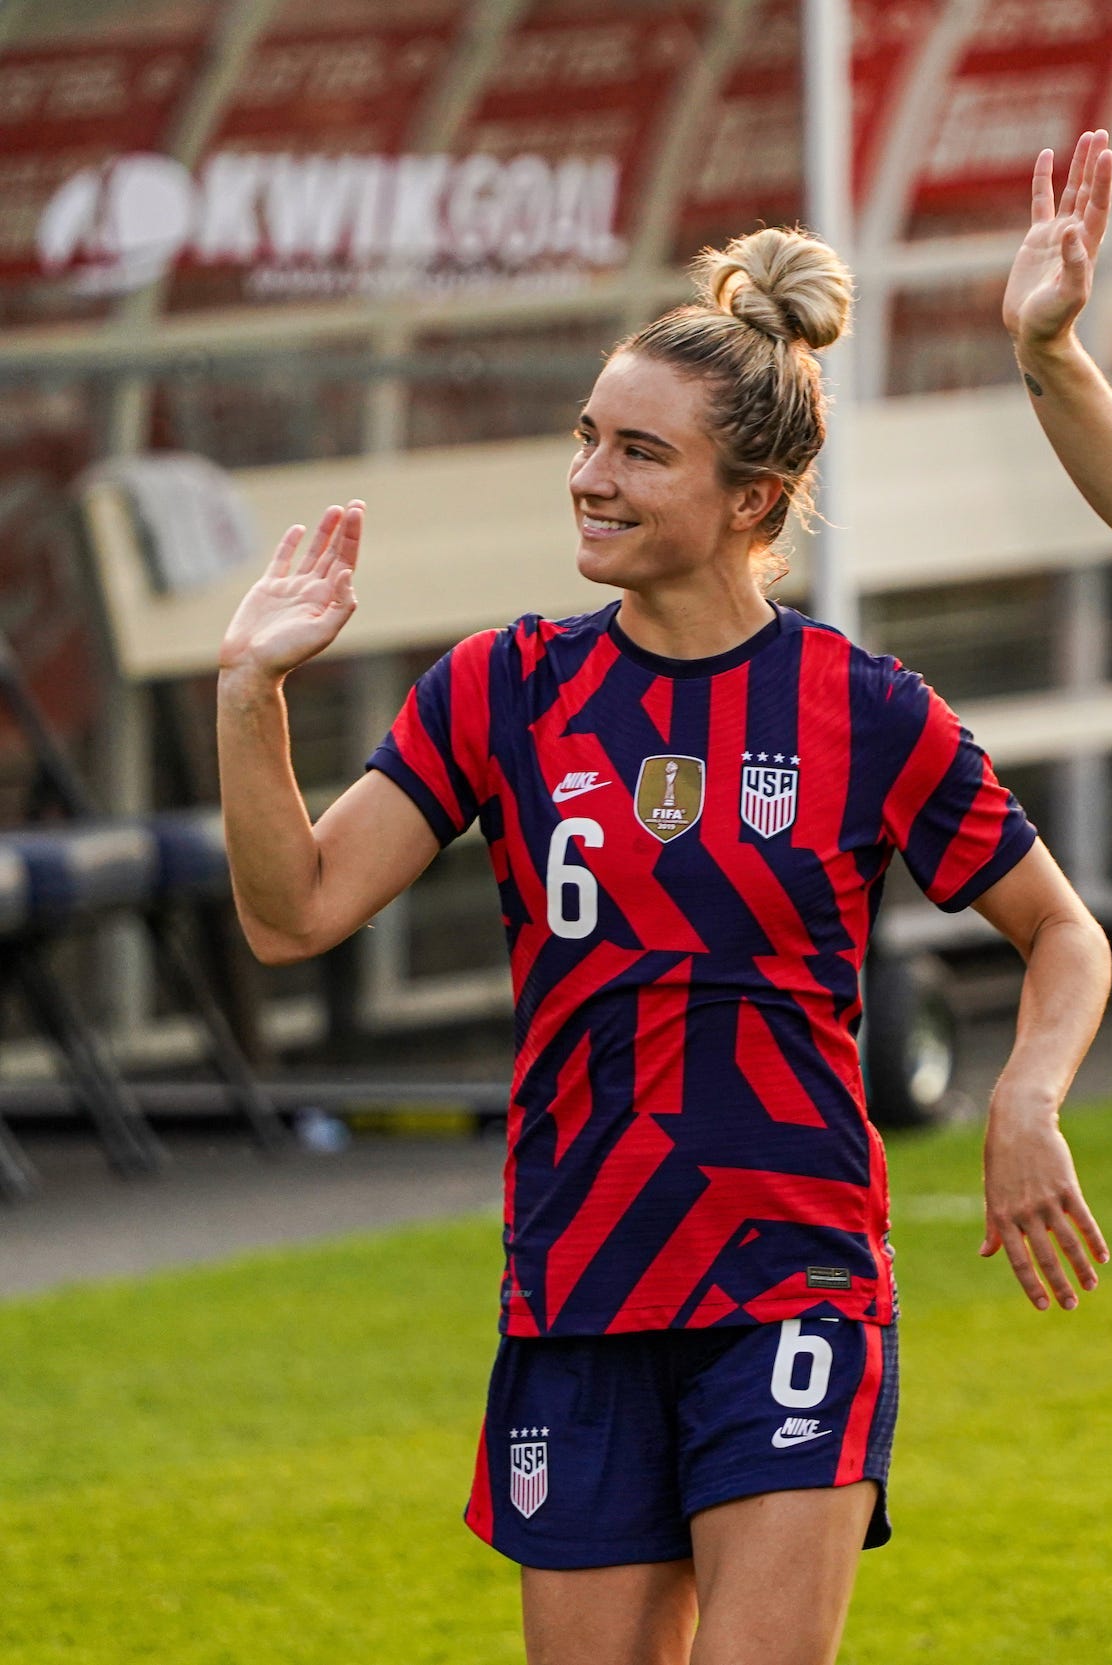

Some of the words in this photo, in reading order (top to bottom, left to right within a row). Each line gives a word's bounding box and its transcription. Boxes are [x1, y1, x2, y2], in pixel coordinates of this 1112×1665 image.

[560, 771, 600, 789] NIKE
[747, 770, 793, 797] USA
[652, 808, 683, 819] FIFA
[546, 817, 605, 939] 6
[770, 1318, 839, 1409] 6
[780, 1417, 821, 1436] NIKE
[513, 1446, 544, 1474] USA
